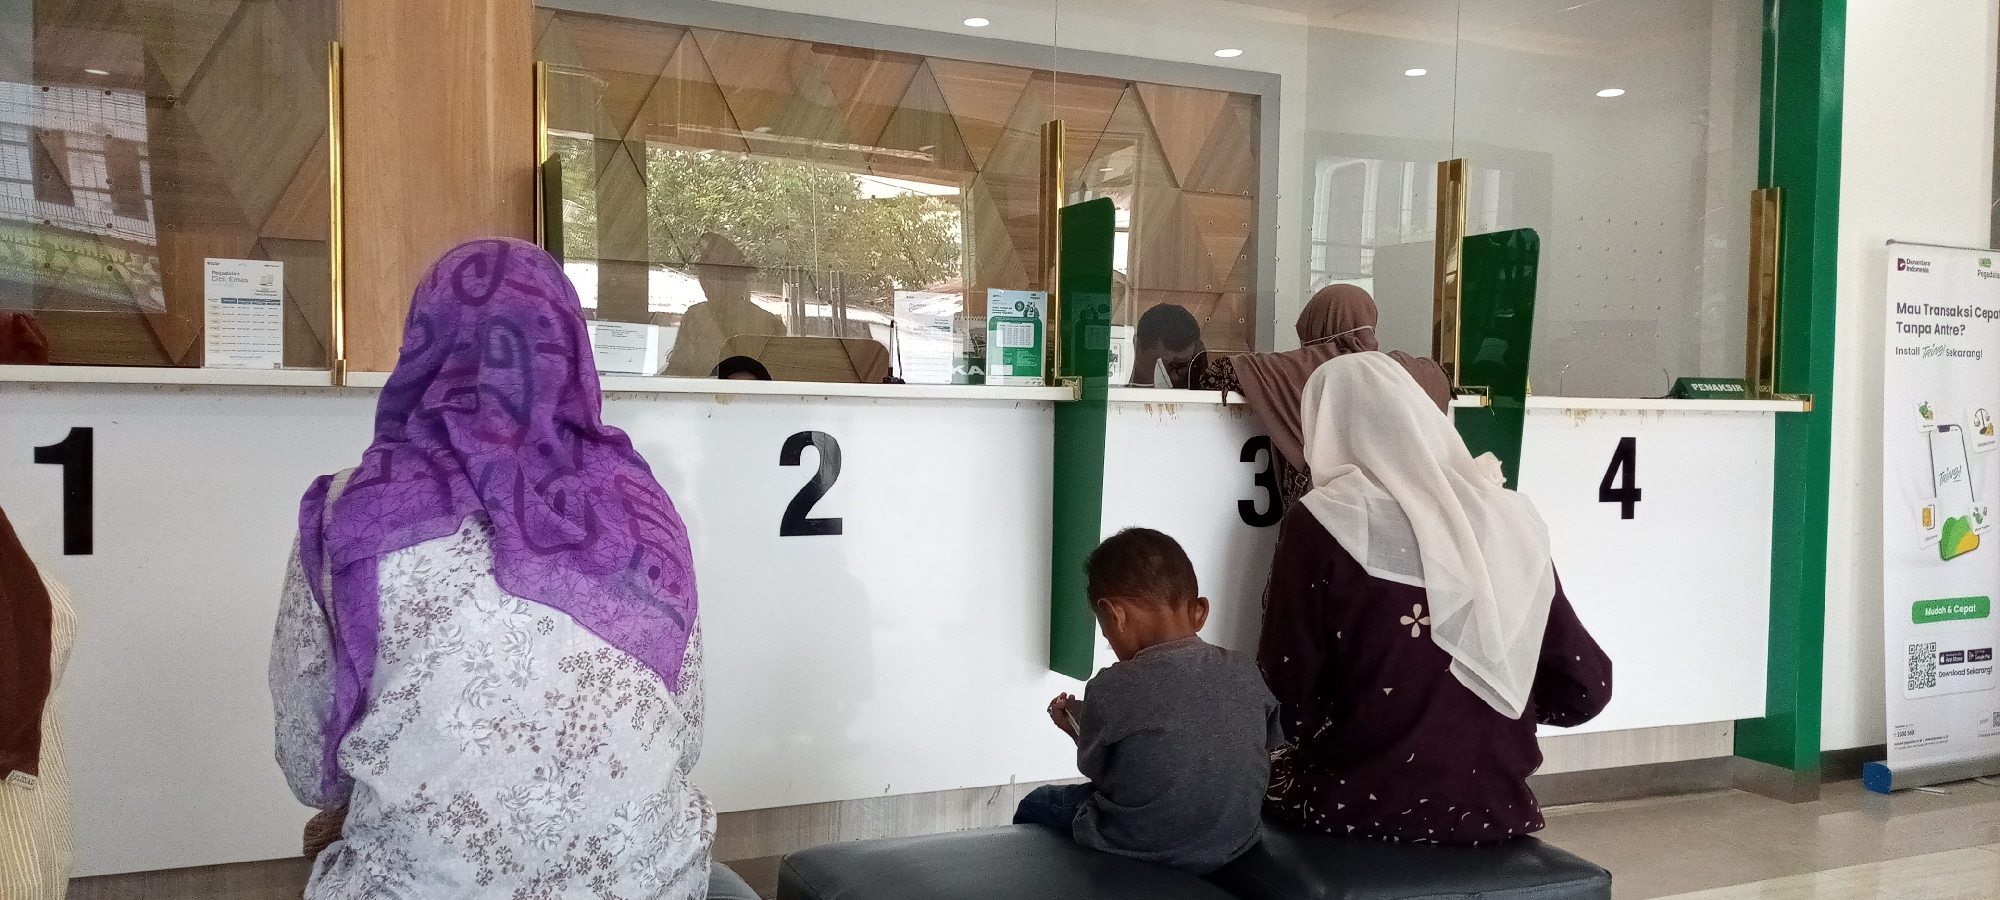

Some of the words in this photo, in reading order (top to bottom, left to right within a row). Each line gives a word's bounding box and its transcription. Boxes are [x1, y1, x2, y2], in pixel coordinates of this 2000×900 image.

[1977, 269, 2000, 279] Pegadaia
[1896, 302, 1921, 315] Mau
[1923, 303, 1973, 318] Transaksi
[1895, 321, 1932, 338] Tanpa
[1934, 323, 1966, 336] Antre?
[1895, 346, 1920, 356] Install
[1946, 348, 1983, 361] Sekarang!
[1690, 383, 1744, 392] PENAKSIR
[779, 431, 842, 536] 2
[1238, 436, 1283, 527] 3
[1599, 437, 1641, 519] 4
[34, 427, 93, 555] 1
[1925, 606, 1946, 616] Mudah
[1947, 605, 1952, 614] &
[1938, 669, 1965, 678] Download
[1966, 665, 1993, 675] Sekarang!
